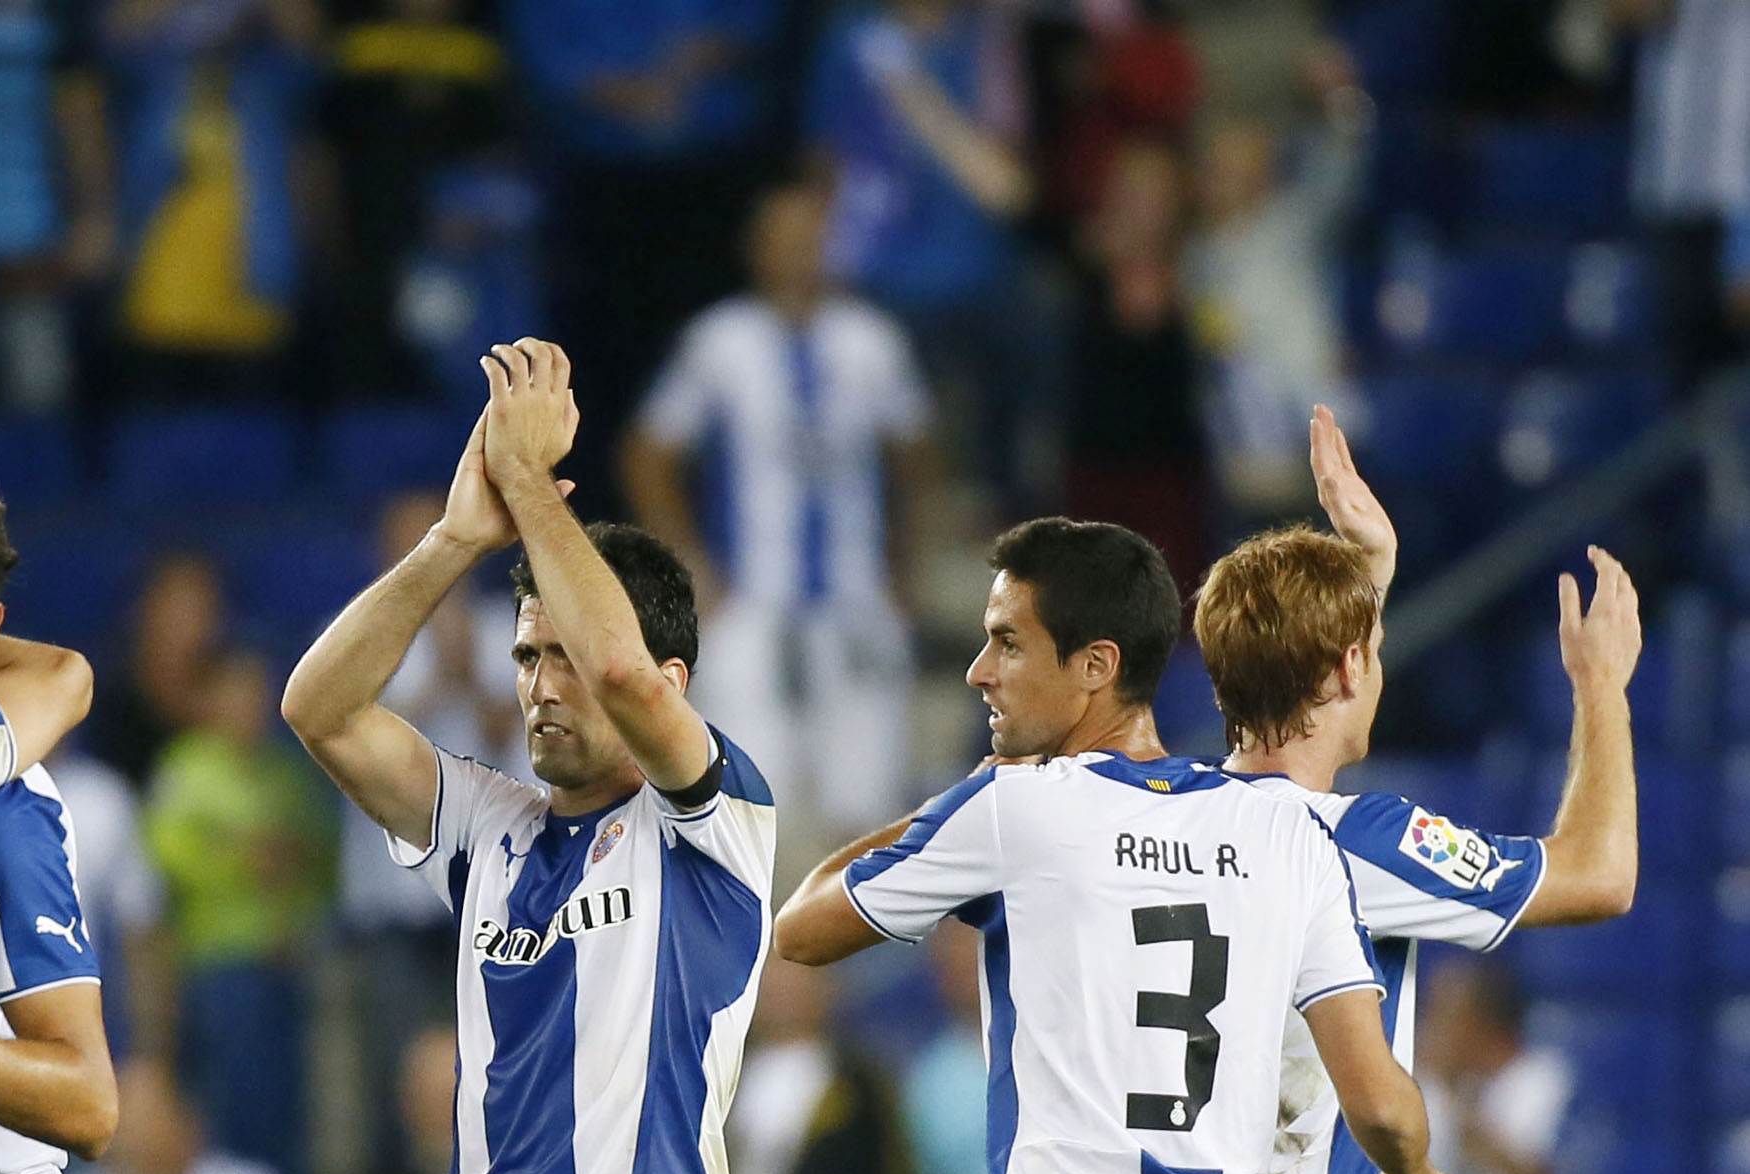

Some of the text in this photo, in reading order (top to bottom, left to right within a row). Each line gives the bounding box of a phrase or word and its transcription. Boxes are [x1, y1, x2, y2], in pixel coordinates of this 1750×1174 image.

[1114, 832, 1249, 879] RAUL R.
[1452, 837, 1486, 884] LFP
[1126, 903, 1230, 1131] 3
